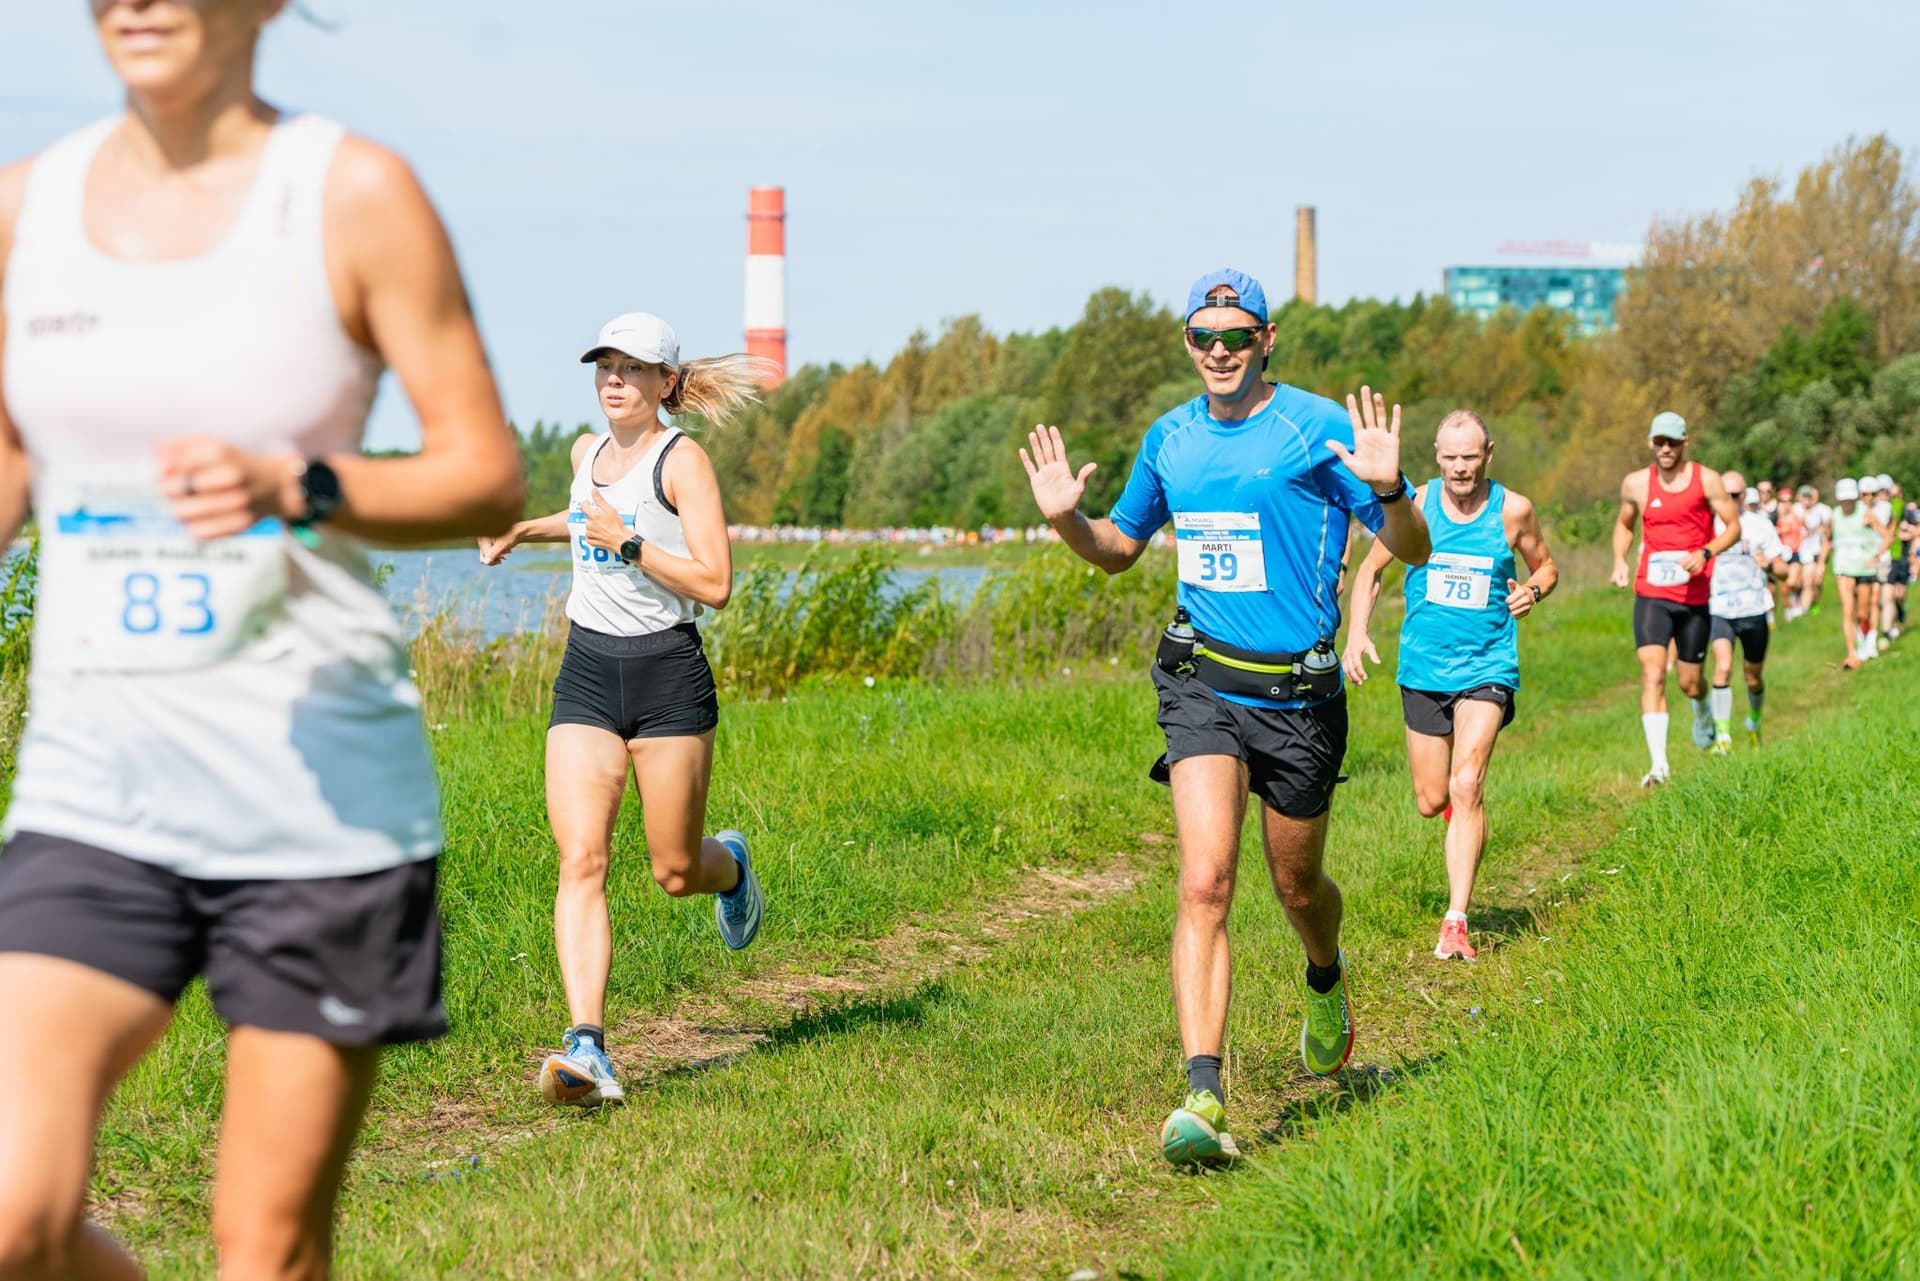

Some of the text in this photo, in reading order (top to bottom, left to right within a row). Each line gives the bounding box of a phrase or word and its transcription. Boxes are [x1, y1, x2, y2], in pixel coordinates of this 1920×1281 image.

[1202, 543, 1232, 552] MARTI
[1199, 553, 1238, 581] 39
[123, 572, 216, 635] 83
[1443, 580, 1472, 600] 78
[1340, 987, 1350, 1034] HOKA
